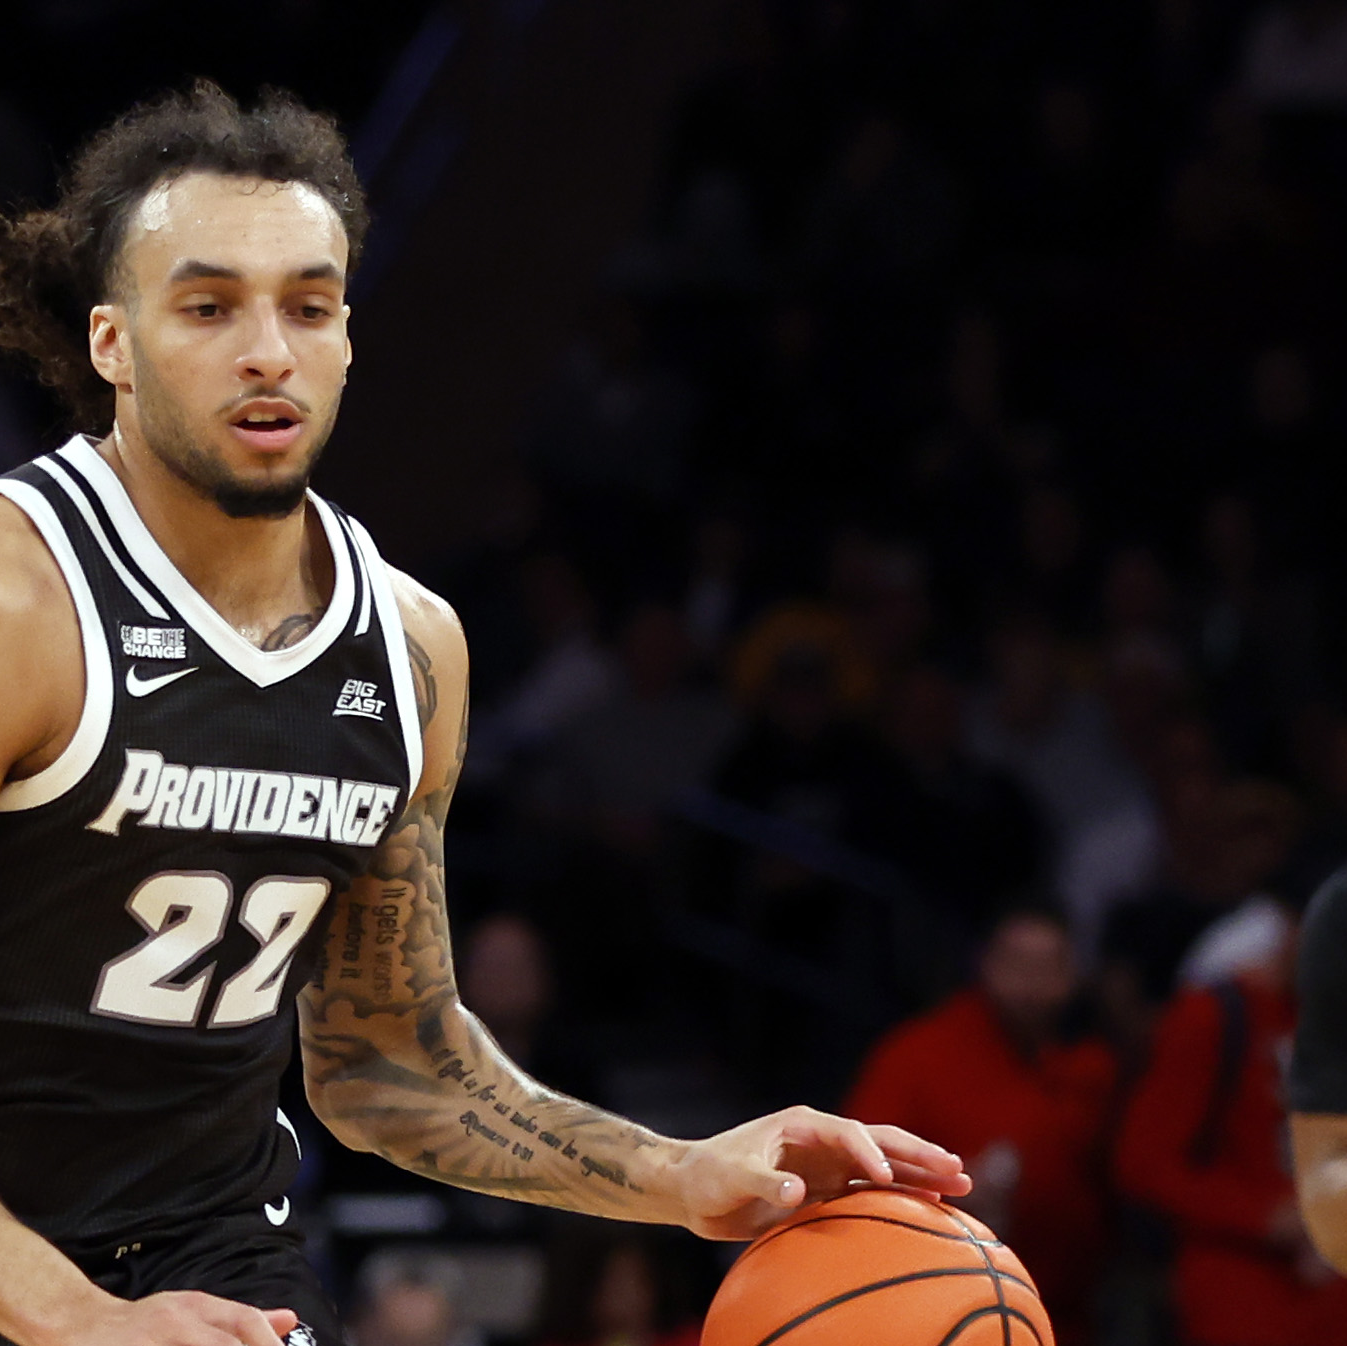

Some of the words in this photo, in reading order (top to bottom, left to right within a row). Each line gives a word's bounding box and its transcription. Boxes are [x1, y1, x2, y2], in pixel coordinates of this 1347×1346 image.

[122, 642, 187, 659] CHANGE
[341, 679, 378, 697] BIG
[336, 694, 387, 714] EAST
[85, 748, 400, 847] PROVIDENCE
[372, 904, 399, 945] gets
[90, 869, 331, 1029] 22
